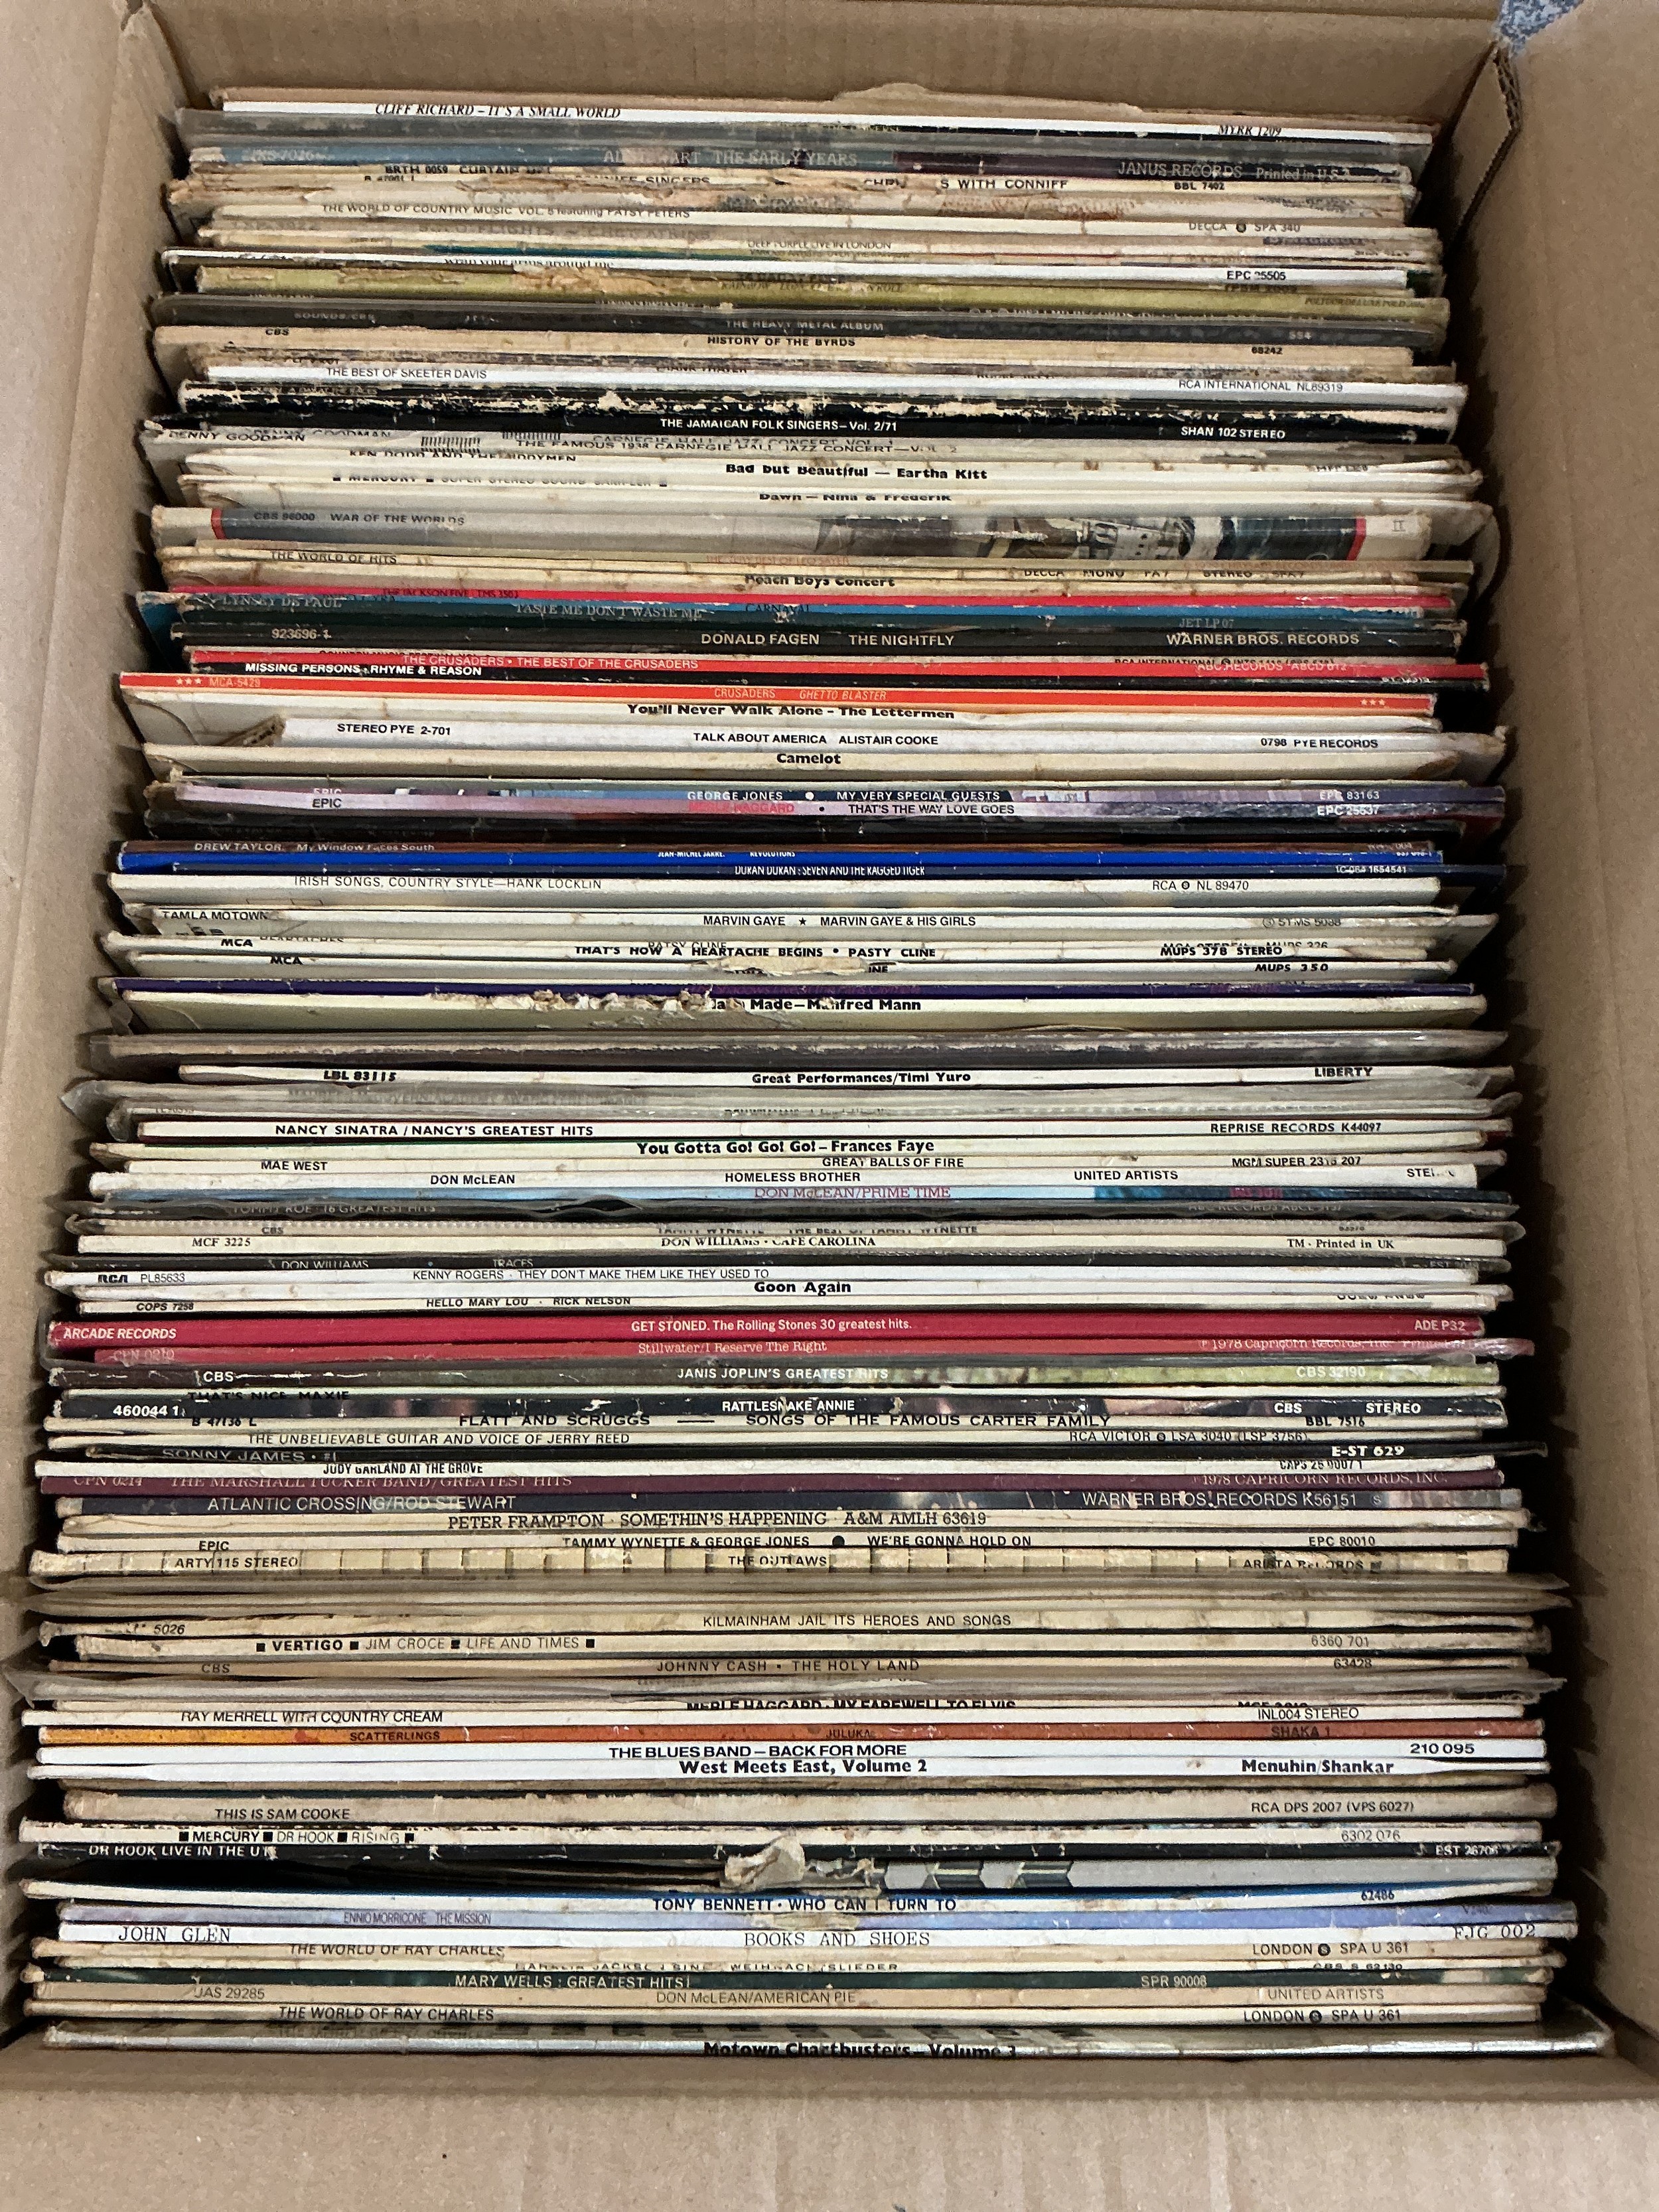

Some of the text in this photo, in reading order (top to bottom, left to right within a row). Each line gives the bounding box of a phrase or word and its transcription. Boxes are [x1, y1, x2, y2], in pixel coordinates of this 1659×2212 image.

[376, 104, 620, 119] CLIFF RICHARD IT'S A SMALL WORLD
[323, 204, 512, 215] THE WORLD OF COUNTRY MUSIC
[708, 336, 855, 347] HISTORY OF THE BYRDS
[327, 368, 486, 379] THE BEST OF SKEETER DAVIS
[1179, 380, 1342, 392] RCA INTERNATIONAL NL89319
[1181, 427, 1285, 439] SHAN 102 STEREO
[726, 464, 987, 479] Bad but Beautiful Eartha Kitt
[701, 633, 820, 644] DONALD FAGEN
[849, 634, 954, 646] THE NIGHTFLY
[1167, 632, 1359, 645] WARNER BROS. RECORDS
[714, 688, 776, 699] CRUSADERS
[800, 690, 887, 701] GHETTO BLASTER
[628, 704, 954, 719] You'll Never Walk Alone The Lettermen
[337, 723, 451, 736] STEREO PYE 2-701
[693, 732, 826, 744] TALK ABOUT AMERICA
[839, 735, 938, 746] ALISTAIR COOKE
[1261, 738, 1378, 749] 0798 PYE RECORDS
[776, 753, 841, 765] Camelot
[687, 791, 783, 800] GEORGE JONES
[837, 791, 999, 801] MY VERY SPECIAL GUESTS
[312, 798, 341, 808] EPIC
[1153, 880, 1249, 891] RCA NL 89470
[163, 911, 267, 921] TAMLA MOTOWN
[703, 915, 785, 926] MARVIN GAYE
[821, 916, 976, 926] MARVIN GAYE & HIS GIRLS
[275, 1125, 593, 1136] NANCY SINATRA NANCY'S GREATEST HITS
[1210, 1123, 1381, 1134] REPRISE RECORDS K44097
[261, 1161, 327, 1171] MAE WEST
[431, 1175, 514, 1185] DON McLEAN
[725, 1172, 860, 1182] HOMELESS BROTHER
[1074, 1170, 1178, 1181] UNITED ARTISTS
[755, 1282, 851, 1295] Goon Again
[632, 1317, 912, 1332] GET STONED. The Rolling Stones 30 greatest hits.
[64, 1328, 177, 1339] ARCADE RECORDS
[1274, 1403, 1421, 1414] CBS STEREO
[449, 1511, 986, 1529] PETER FRAMPTON SOMETHIN'S HAPPENING A&M AMLH 63619
[703, 1614, 1011, 1627] KILMAINHAM JAIL ITS HEROES AND SONGS
[273, 1641, 342, 1651] VERTIGO
[657, 1660, 920, 1672] JOHNNY CASH THE HOLY LAND
[1411, 1743, 1475, 1754] 210 095
[680, 1759, 927, 1775] West Meets East, Volume 2
[214, 1808, 350, 1819] THIS IS SAM COOKE
[119, 1927, 230, 1942] JOHN GLEN
[744, 1932, 930, 1946] BOOKS AND SHOES
[1141, 1976, 1169, 1988] SPR
[279, 2006, 494, 2022] THE WORLD OF RAY CHARLES
